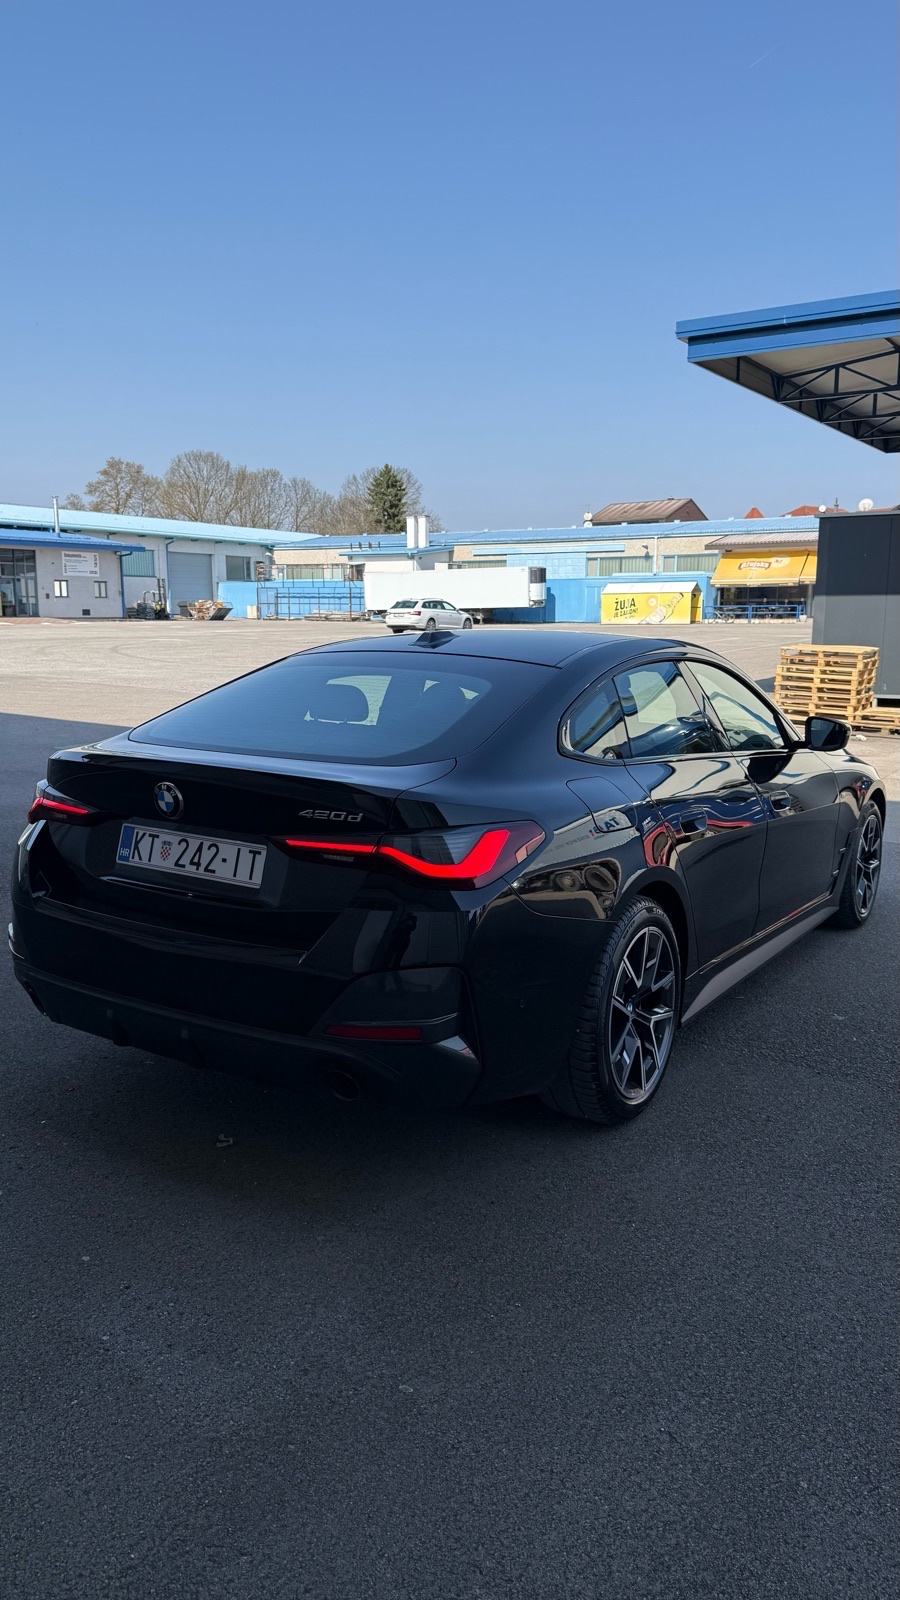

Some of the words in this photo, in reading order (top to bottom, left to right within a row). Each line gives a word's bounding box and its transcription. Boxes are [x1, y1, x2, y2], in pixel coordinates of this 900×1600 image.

[297, 808, 364, 823] 420d
[120, 847, 130, 858] HR
[131, 830, 160, 862] KT
